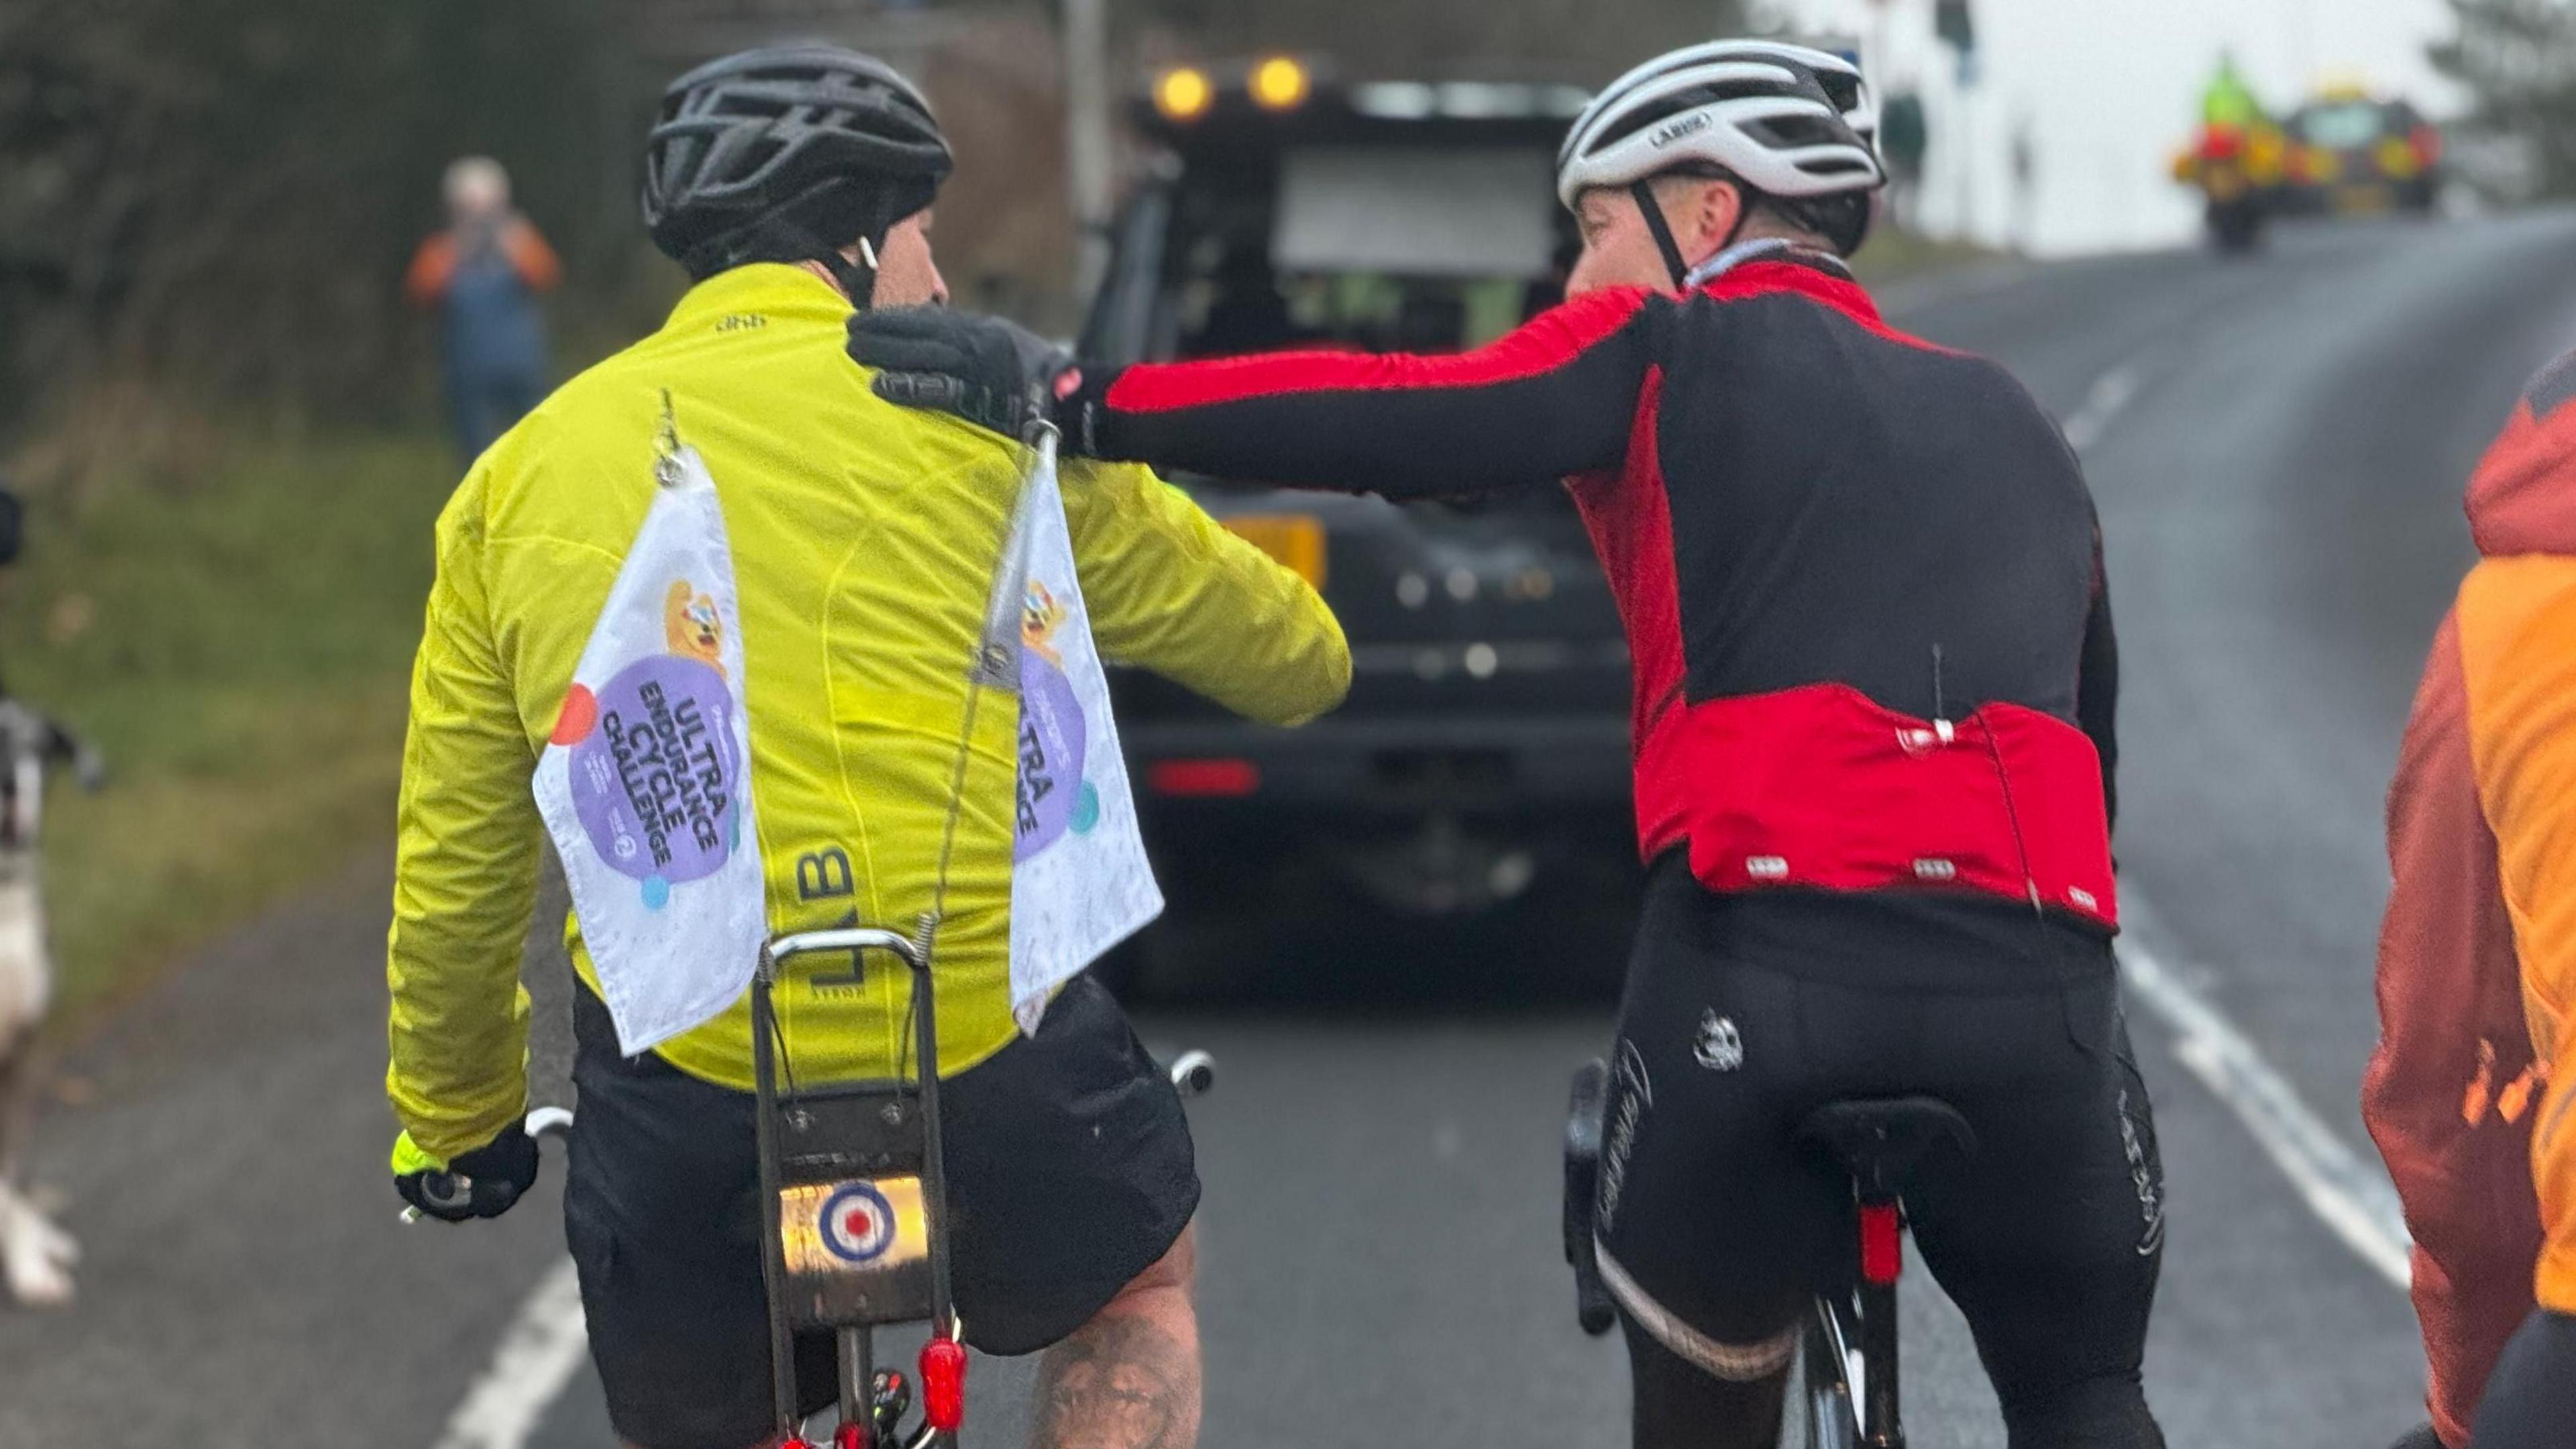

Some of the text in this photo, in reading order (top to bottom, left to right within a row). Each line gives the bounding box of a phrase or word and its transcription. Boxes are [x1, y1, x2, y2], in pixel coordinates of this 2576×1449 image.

[602, 710, 673, 868] CHALLENGE
[629, 722, 687, 833] CYCLE
[639, 680, 719, 853] ENDURANCE
[675, 696, 727, 818] ULTRA
[1018, 698, 1055, 804] TRA
